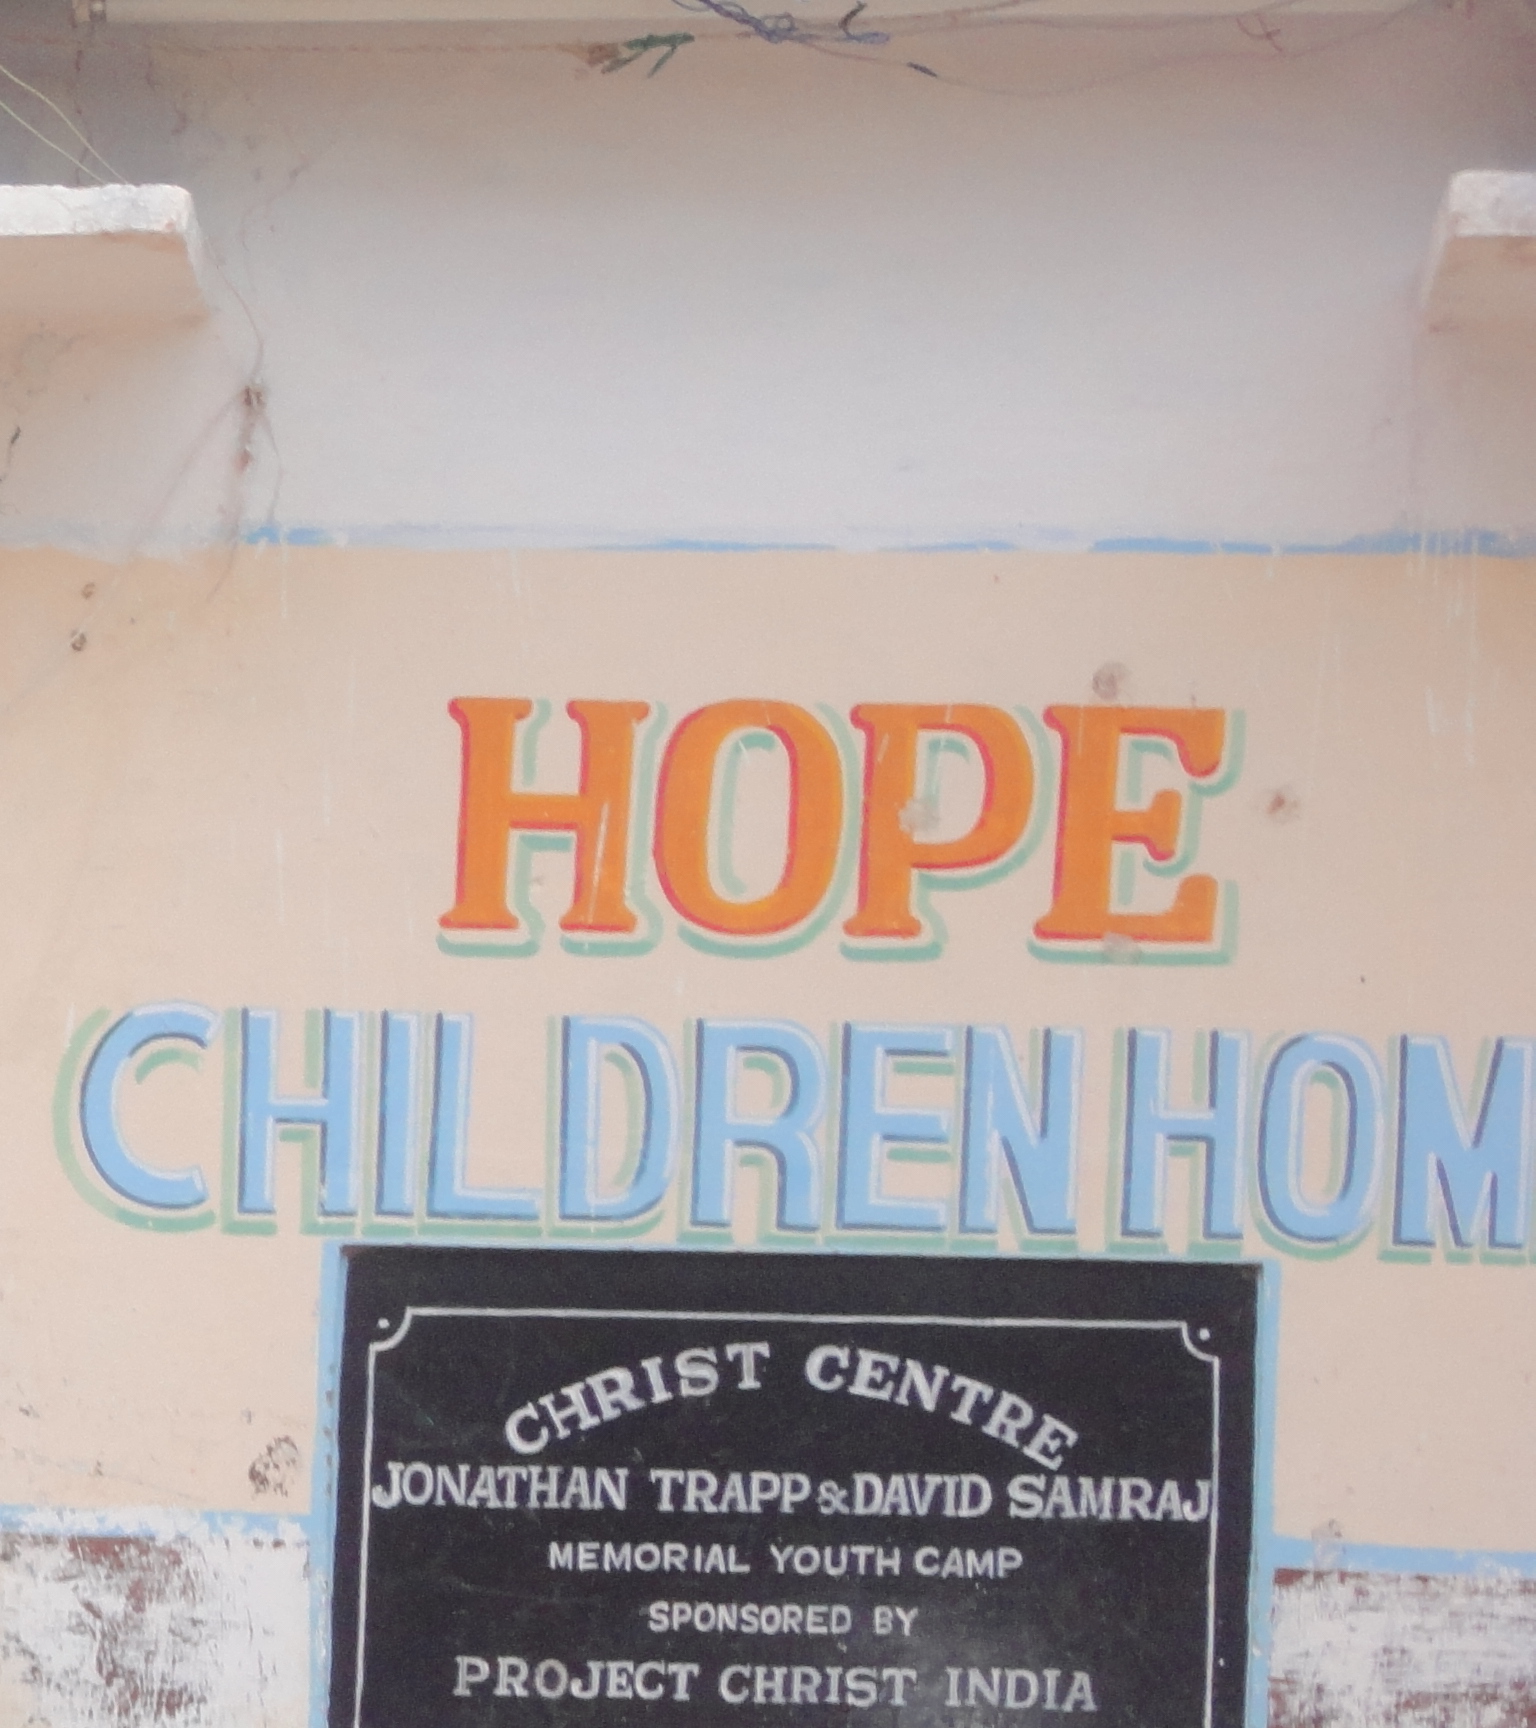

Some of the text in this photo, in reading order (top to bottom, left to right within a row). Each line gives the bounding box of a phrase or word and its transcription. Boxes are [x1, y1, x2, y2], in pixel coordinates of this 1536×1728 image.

[436, 695, 1236, 962] HOPE
[63, 1002, 1078, 1248] CHILDREN
[505, 1341, 1079, 1471] CHRIST CENTRE
[372, 1460, 629, 1509] JONATHAN
[1007, 1475, 1213, 1522] SAMRAJ
[548, 1541, 1024, 1580] MEMORIAL YOUTH CAMP
[648, 1601, 918, 1636] SPONSORED BY
[453, 1655, 1098, 1713] PROJECT CHRIST INDIA
